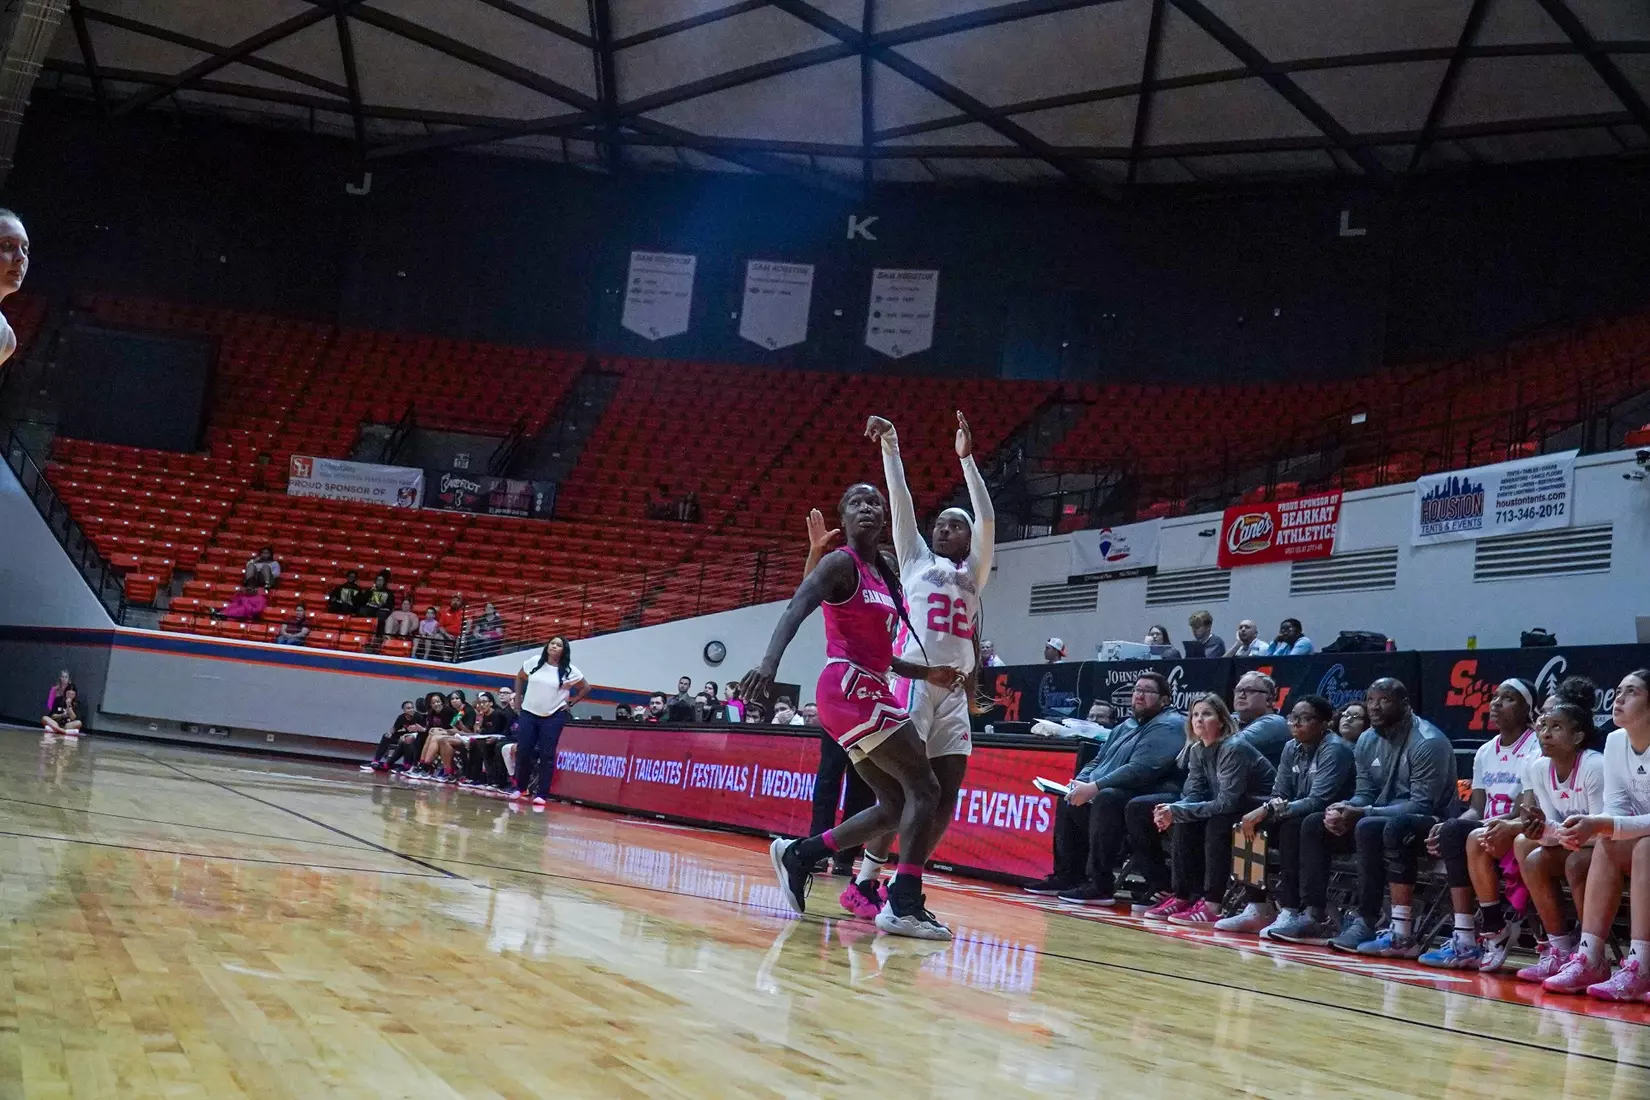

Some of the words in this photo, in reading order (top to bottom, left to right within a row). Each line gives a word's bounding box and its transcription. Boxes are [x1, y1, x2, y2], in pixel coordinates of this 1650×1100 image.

[346, 172, 372, 195] J
[847, 215, 879, 240] K
[1340, 211, 1366, 236] L
[288, 480, 322, 490] PROUD
[324, 483, 371, 495] SPONSOR
[372, 488, 386, 496] OF
[1278, 501, 1298, 512] PROUD
[1300, 497, 1329, 508] SPONSOR
[1331, 495, 1340, 504] OF
[1421, 492, 1485, 523] HOUSTON
[1496, 492, 1566, 508] houstontents.com
[1281, 506, 1336, 528] BEARKAT
[1496, 503, 1565, 524] 713-346-2012
[1276, 523, 1337, 545] ATHLETICS
[1421, 522, 1443, 533] TENTS
[1444, 522, 1450, 531] &
[1452, 518, 1483, 530] EVENTS
[927, 593, 977, 640] 22
[556, 752, 598, 775] CORPORATE
[598, 757, 627, 777] EVENTS
[635, 759, 683, 784] TAILGATES
[690, 763, 749, 792] FESTIVALS
[761, 769, 817, 802] WEDDIN
[967, 789, 1052, 833] EVENTS
